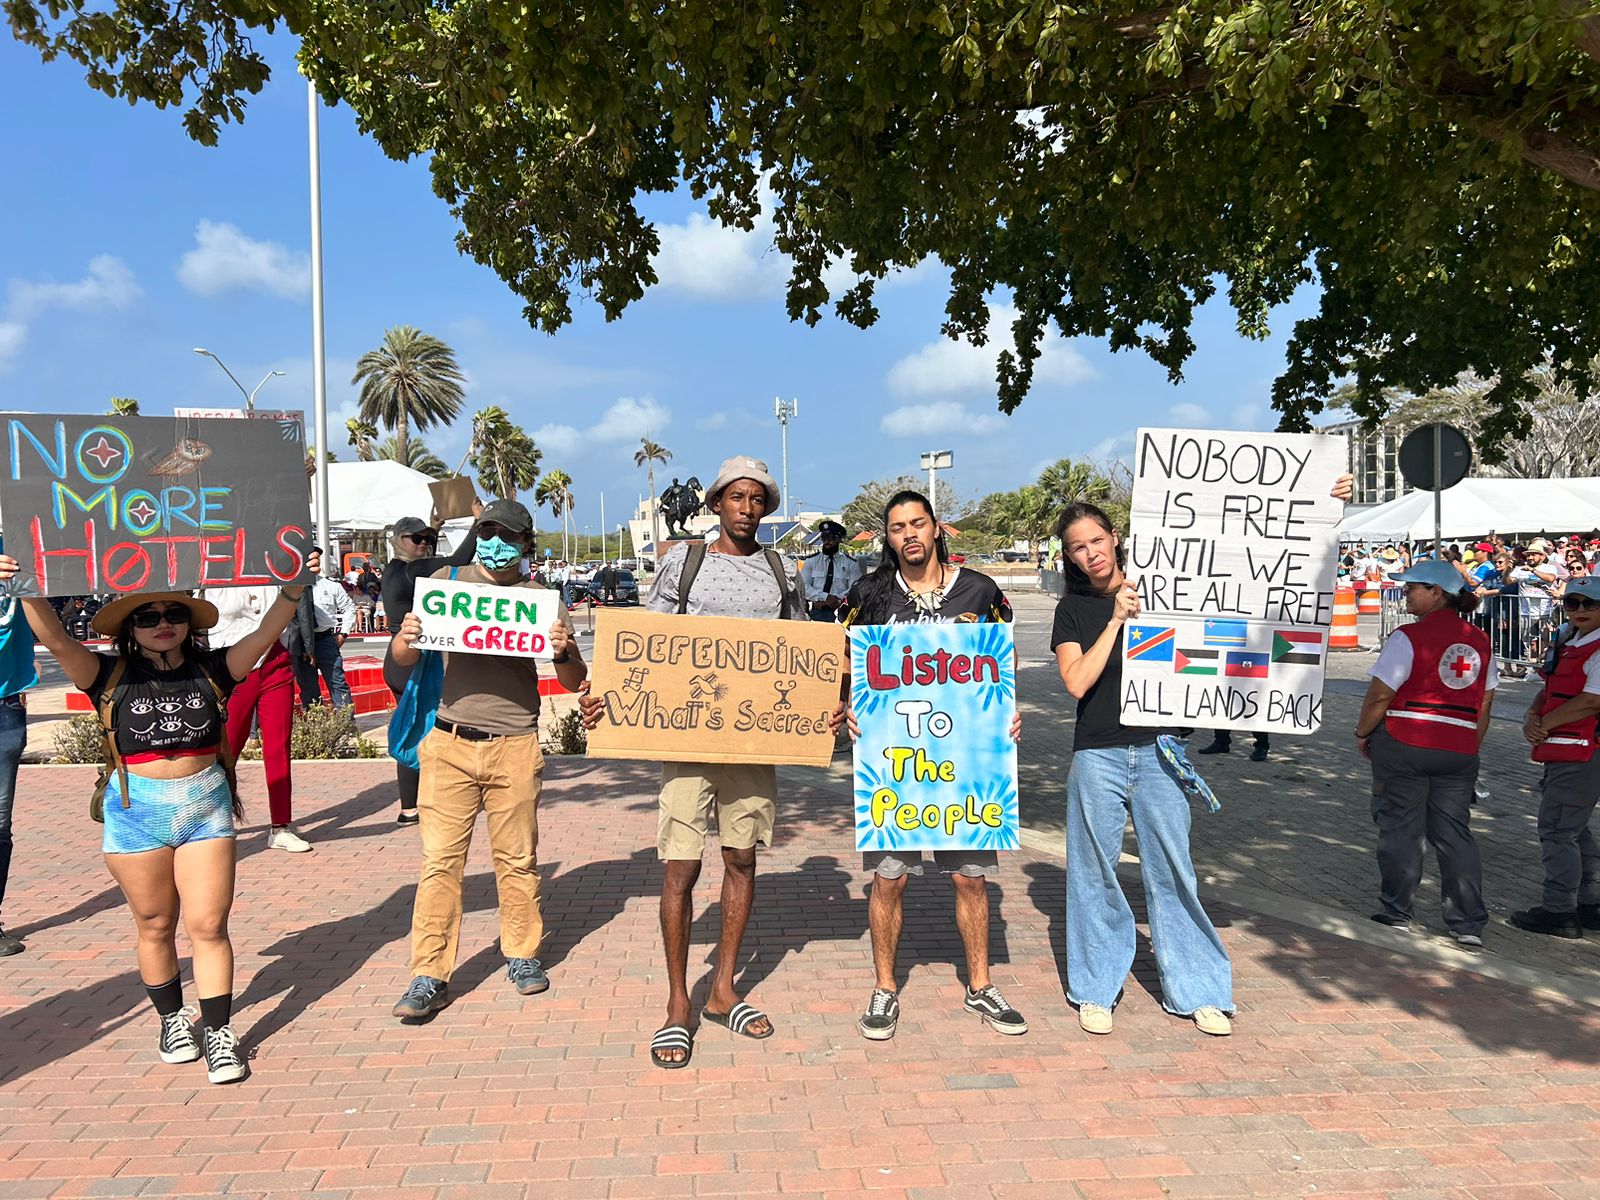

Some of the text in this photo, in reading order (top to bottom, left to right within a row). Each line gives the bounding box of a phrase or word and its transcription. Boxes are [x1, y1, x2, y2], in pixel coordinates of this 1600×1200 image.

[8, 418, 134, 484] NO
[1140, 432, 1312, 492] NOBODY
[52, 481, 233, 536] MORE
[1162, 490, 1315, 541] IS FREE
[1133, 533, 1310, 587] UNTIL WE
[421, 590, 537, 625] GREEN
[1136, 575, 1333, 626] ARE ALL FREE
[417, 625, 545, 653] OVER GREED
[866, 644, 1000, 691] Listen
[735, 699, 829, 737] Sacred
[895, 700, 952, 738] To
[1122, 679, 1323, 730] ALL LANDS BACK
[883, 747, 955, 783] The
